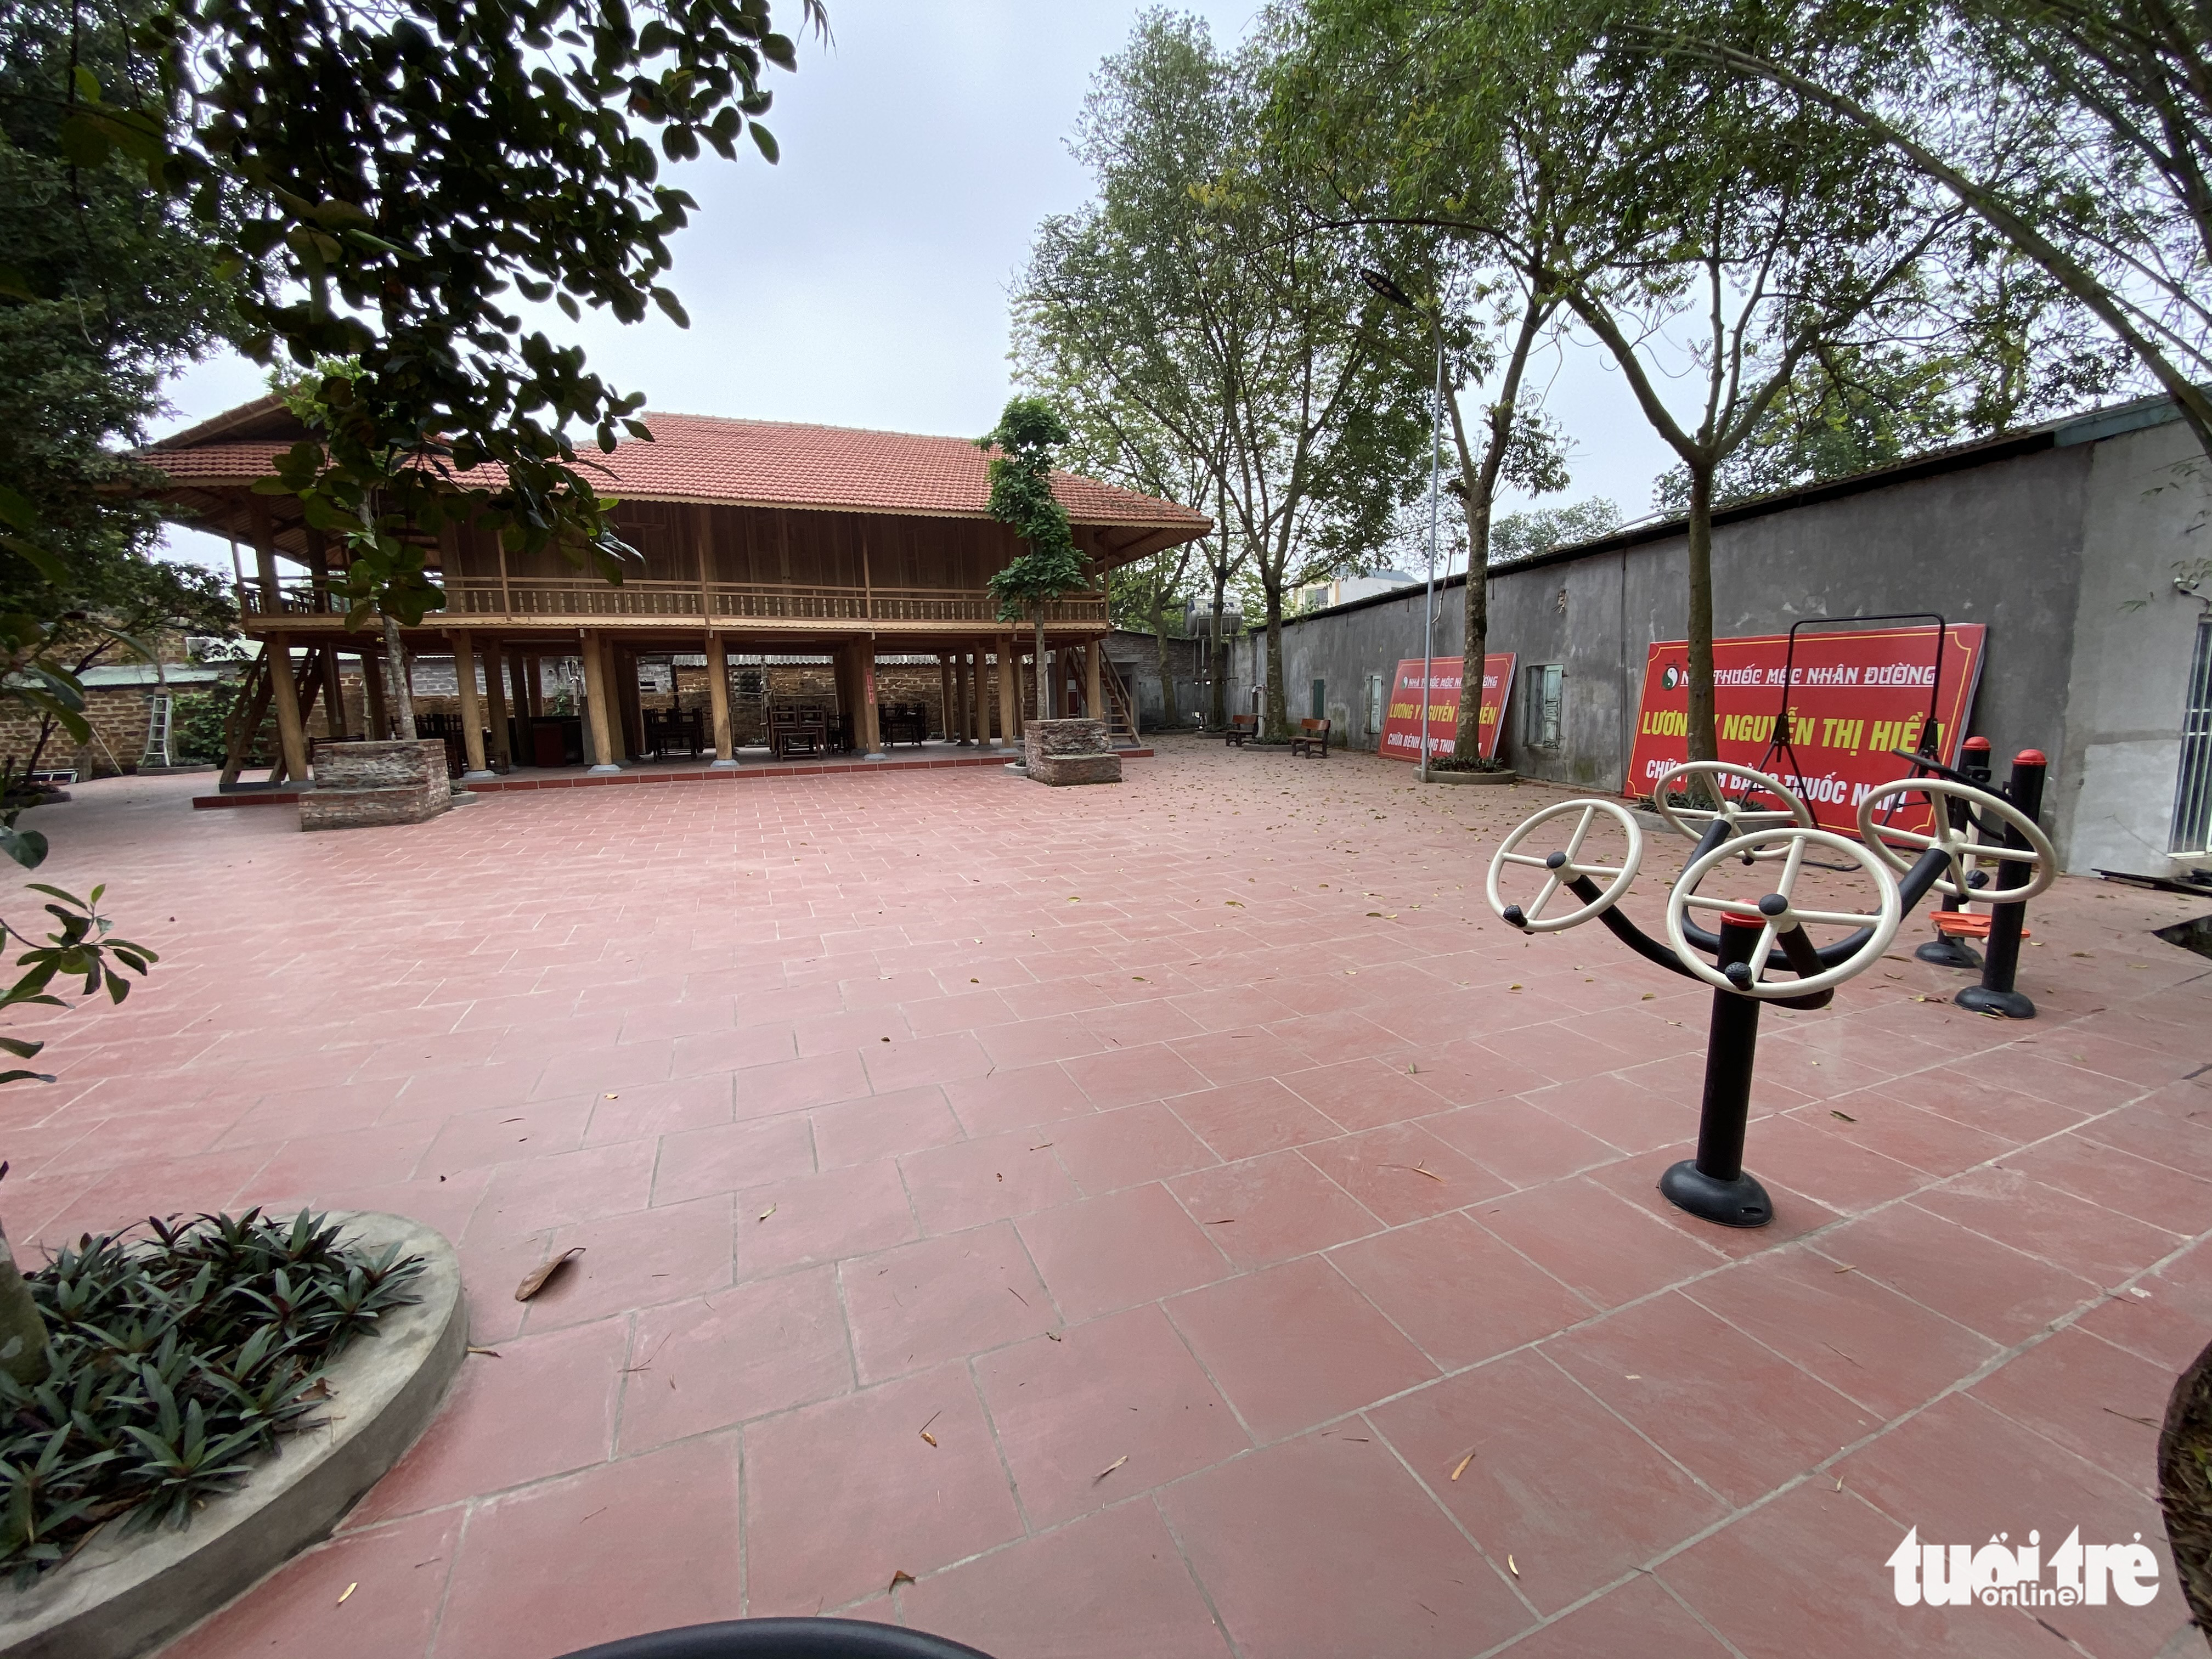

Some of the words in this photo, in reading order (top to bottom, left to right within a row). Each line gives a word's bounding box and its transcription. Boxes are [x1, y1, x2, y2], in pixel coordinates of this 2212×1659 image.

[1713, 663, 1763, 684] THUỐC
[1808, 663, 1859, 684] NHÂN
[1864, 662, 1936, 685] ĐƯỜNG
[1389, 703, 1414, 719] LƯƠNG
[1414, 704, 1421, 719] Y
[1387, 731, 1403, 746] CHỮA
[1403, 732, 1420, 750] BỆNH
[1642, 709, 1688, 737] LƯƠN
[1821, 718, 1864, 756] THỊ
